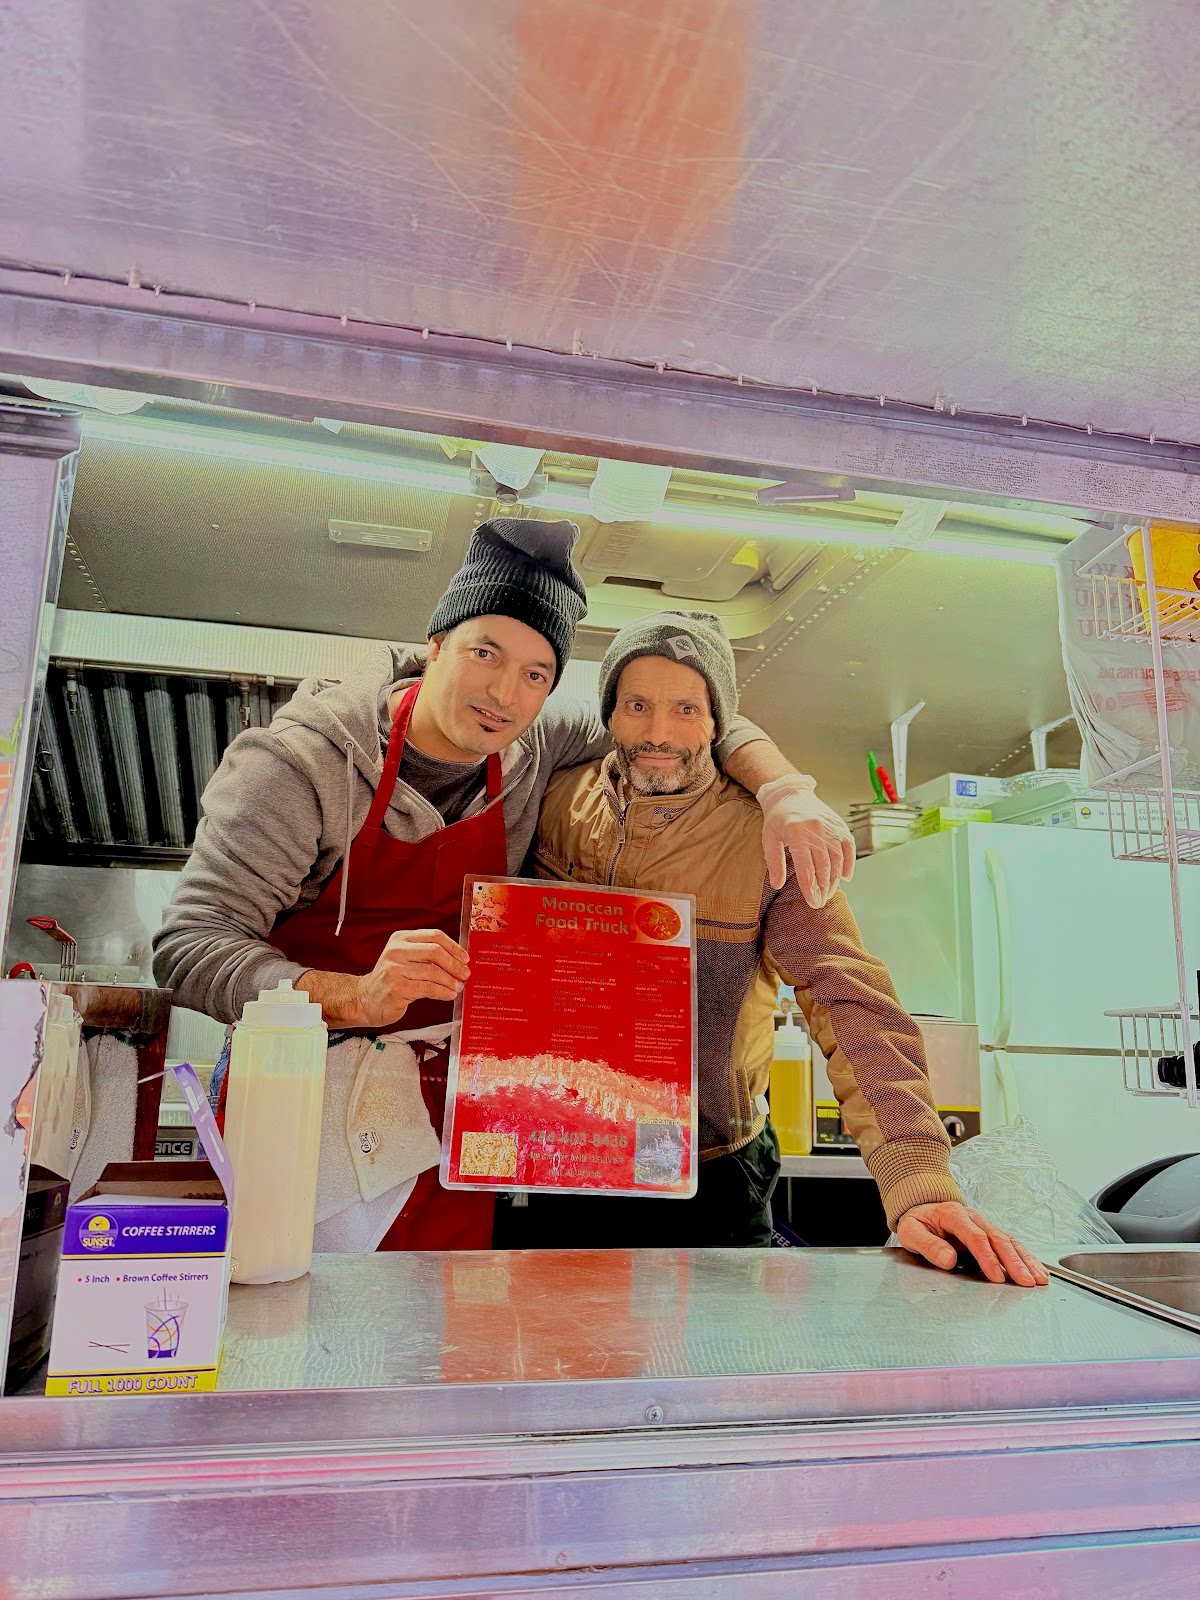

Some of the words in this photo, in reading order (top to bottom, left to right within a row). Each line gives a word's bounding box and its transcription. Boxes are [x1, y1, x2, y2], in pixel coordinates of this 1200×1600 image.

[543, 896, 623, 916] Moroccan
[536, 913, 578, 929] Food
[583, 917, 629, 935] Truck
[528, 1130, 628, 1148] 484-403-8436
[570, 1153, 588, 1162] AND
[590, 1154, 625, 1164] DELIVER
[121, 1226, 164, 1237] COFFEE
[165, 1225, 216, 1237] STIRRERS
[82, 1237, 114, 1248] SUNSET
[85, 1275, 90, 1283] 5
[92, 1274, 110, 1283] Inch
[122, 1274, 149, 1283] Brown
[151, 1273, 178, 1282] Coffee
[179, 1272, 209, 1281] Stirrers
[68, 1380, 102, 1394] FULL
[107, 1378, 142, 1392] 1000
[146, 1375, 198, 1390] COUNT
